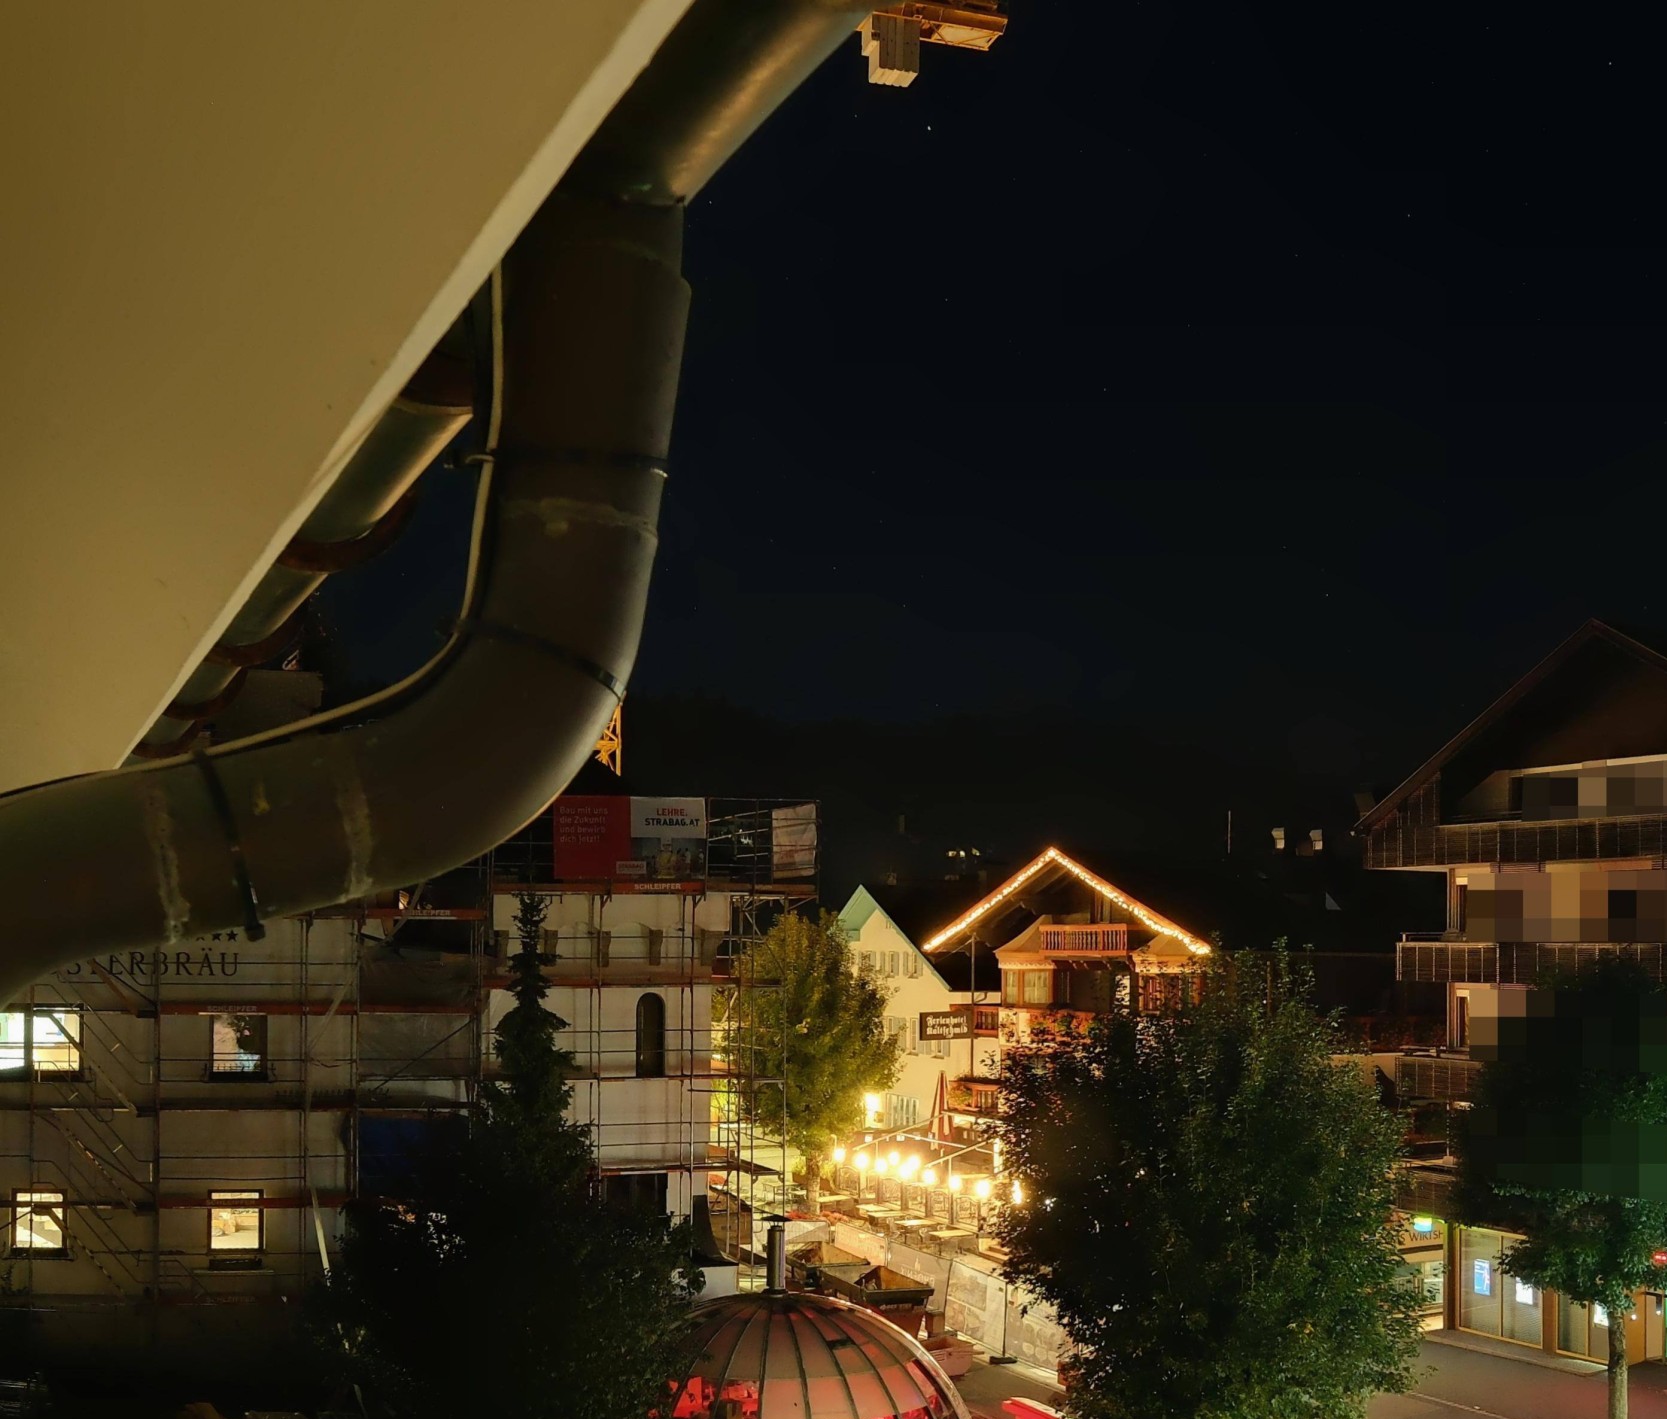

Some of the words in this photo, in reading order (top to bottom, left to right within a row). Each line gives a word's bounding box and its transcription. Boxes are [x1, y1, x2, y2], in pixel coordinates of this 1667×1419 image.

[577, 806, 592, 815] mit
[656, 807, 688, 817] LEHRE.
[559, 816, 573, 824] die
[574, 816, 606, 824] Zukunft
[644, 818, 701, 827] STRABAG.AT
[559, 826, 576, 834] und
[634, 883, 682, 891] SCHLEIPFER
